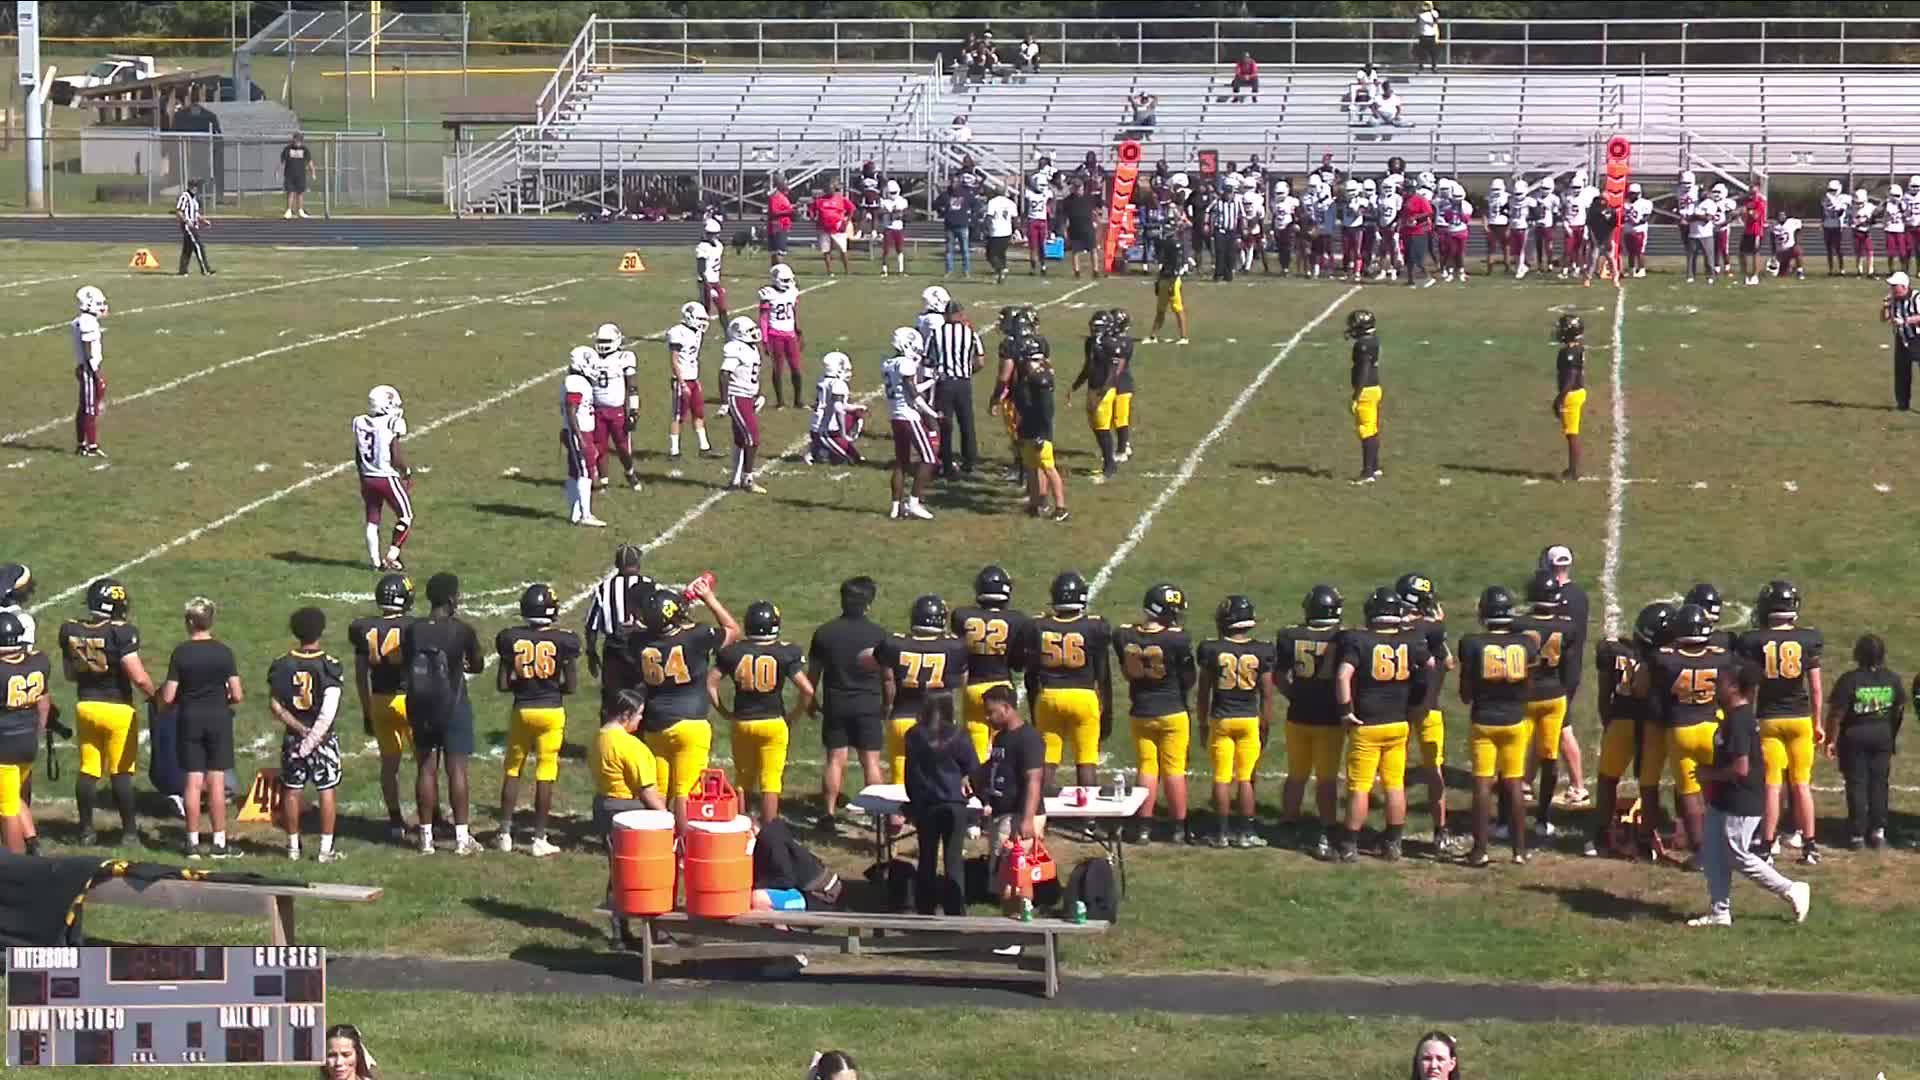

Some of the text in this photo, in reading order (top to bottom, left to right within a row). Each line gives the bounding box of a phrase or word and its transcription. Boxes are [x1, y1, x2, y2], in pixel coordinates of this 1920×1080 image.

[135, 251, 147, 266] 20
[624, 255, 637, 269] 30
[775, 303, 794, 321] 20
[364, 431, 376, 464] 3
[111, 586, 126, 600] 55
[366, 627, 401, 665] 14
[963, 617, 1009, 656] 22
[1041, 631, 1086, 669] 56
[514, 638, 557, 680] 26
[641, 645, 692, 686] 64
[734, 653, 778, 693] 40
[900, 651, 946, 689] 77
[1371, 643, 1410, 682] 61
[1483, 643, 1528, 683] 60
[1763, 640, 1803, 680] 18
[7, 671, 45, 708] 62
[293, 671, 313, 711] 3
[1671, 667, 1719, 704] 45
[702, 803, 715, 818] G
